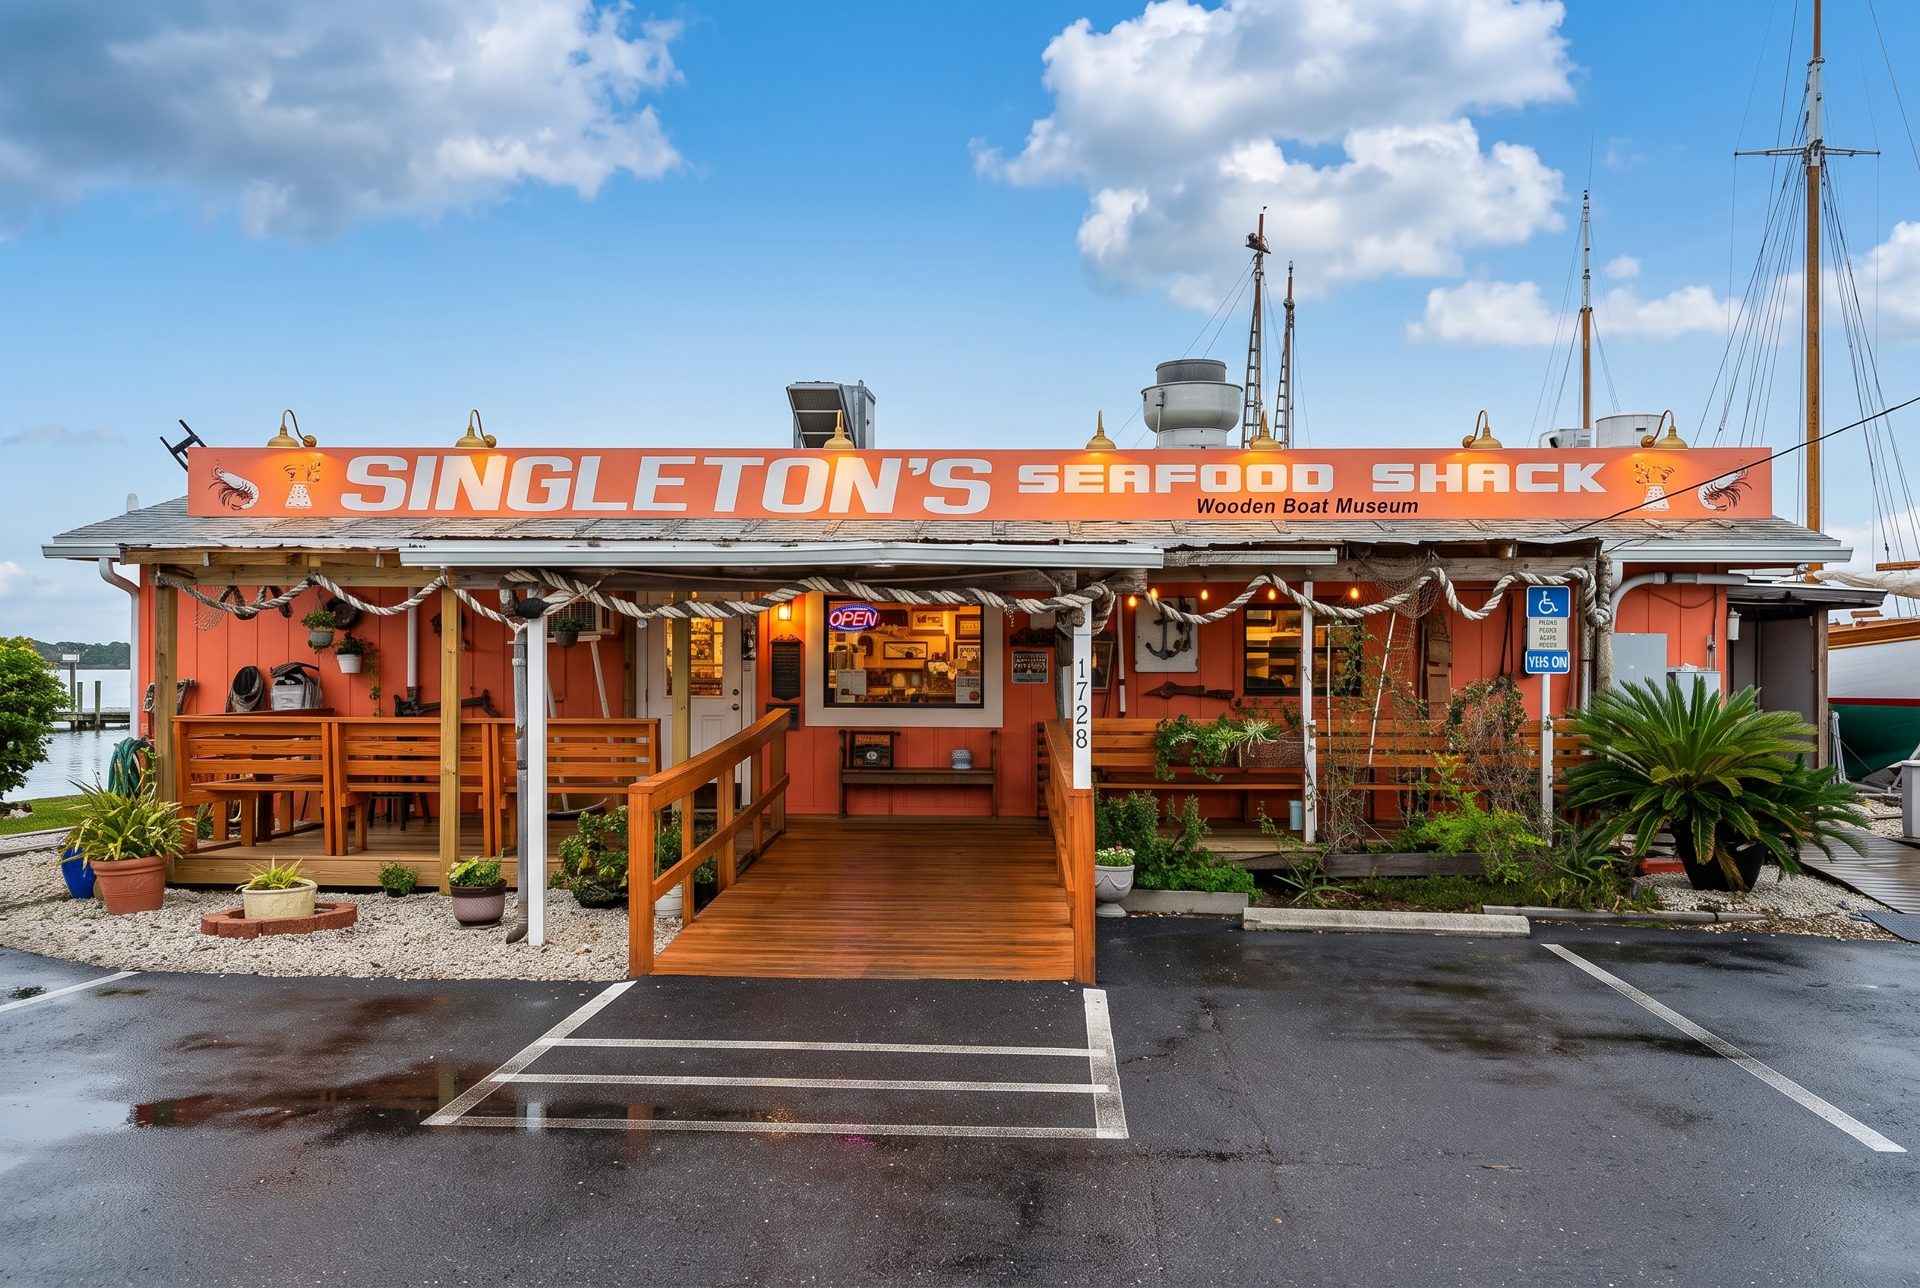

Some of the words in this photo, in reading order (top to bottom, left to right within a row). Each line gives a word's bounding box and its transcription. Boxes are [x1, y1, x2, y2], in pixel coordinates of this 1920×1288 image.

[340, 455, 993, 514] SINGLETON'S
[1018, 463, 1335, 494] SEAFOOD
[1372, 463, 1607, 494] SHACK
[1197, 498, 1276, 514] Wooden
[1283, 498, 1329, 514] Boat
[1335, 497, 1419, 514] Museum
[829, 611, 878, 627] OPEN
[1076, 658, 1088, 748] 1728
